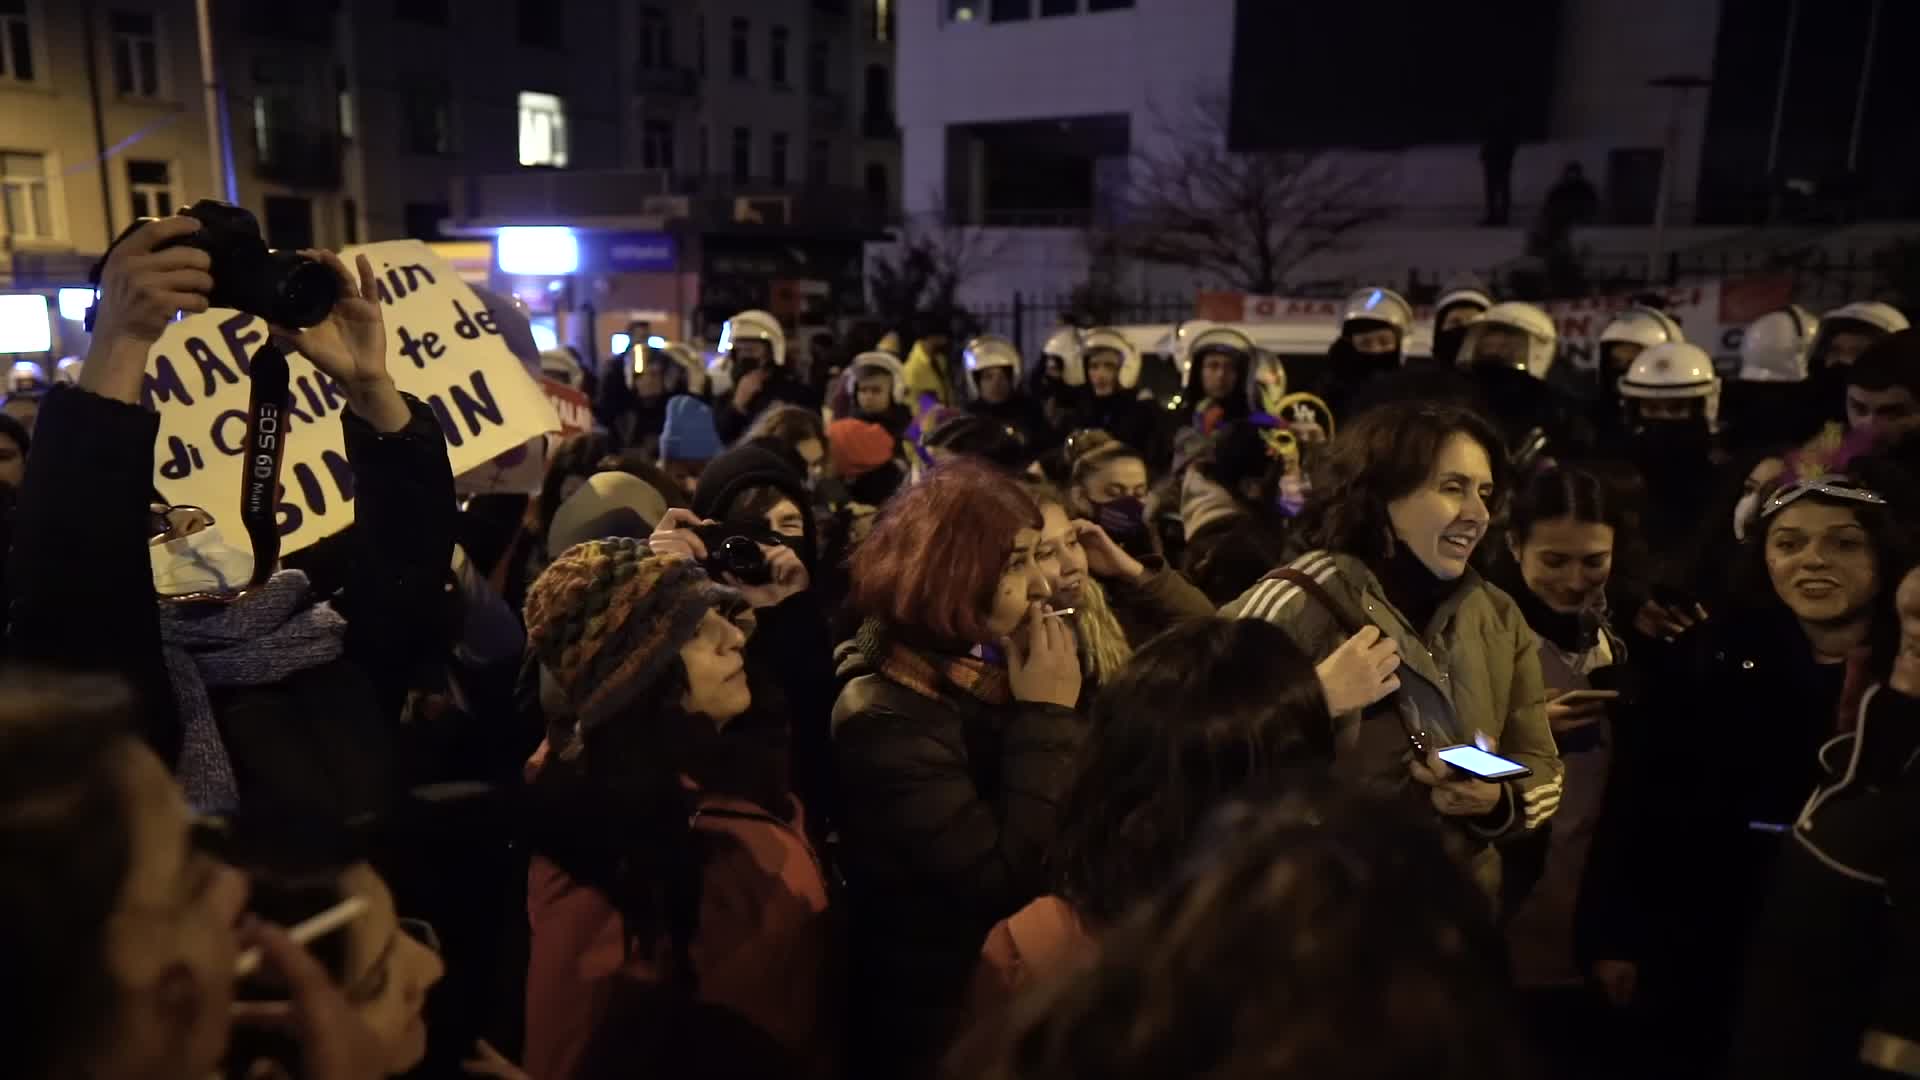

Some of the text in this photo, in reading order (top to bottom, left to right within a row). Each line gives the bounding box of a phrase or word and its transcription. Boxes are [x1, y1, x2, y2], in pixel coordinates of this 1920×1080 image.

[397, 326, 446, 369] te
[257, 402, 278, 451] EOS
[253, 454, 273, 480] 6D
